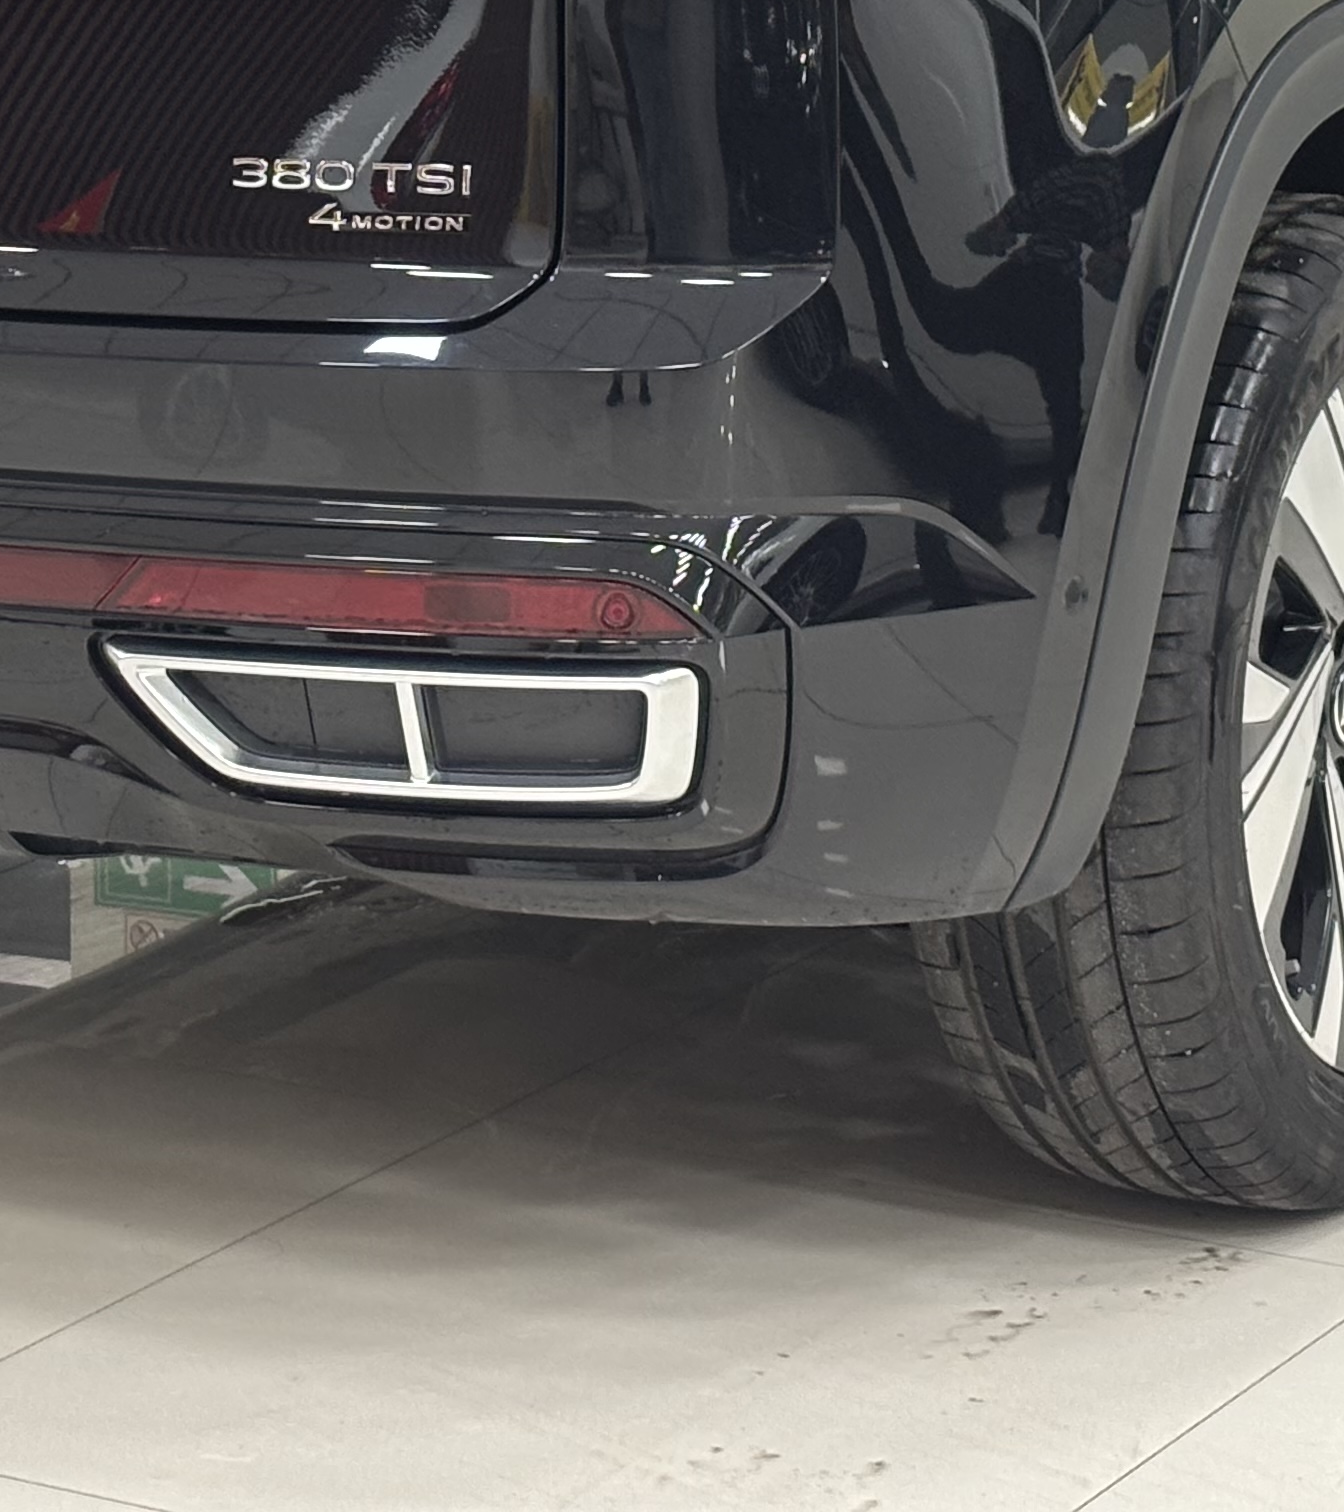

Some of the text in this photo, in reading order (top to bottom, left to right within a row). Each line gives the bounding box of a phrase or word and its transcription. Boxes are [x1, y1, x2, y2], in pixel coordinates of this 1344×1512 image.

[232, 157, 472, 196] 380 TSI
[308, 202, 464, 232] 4MOTION
